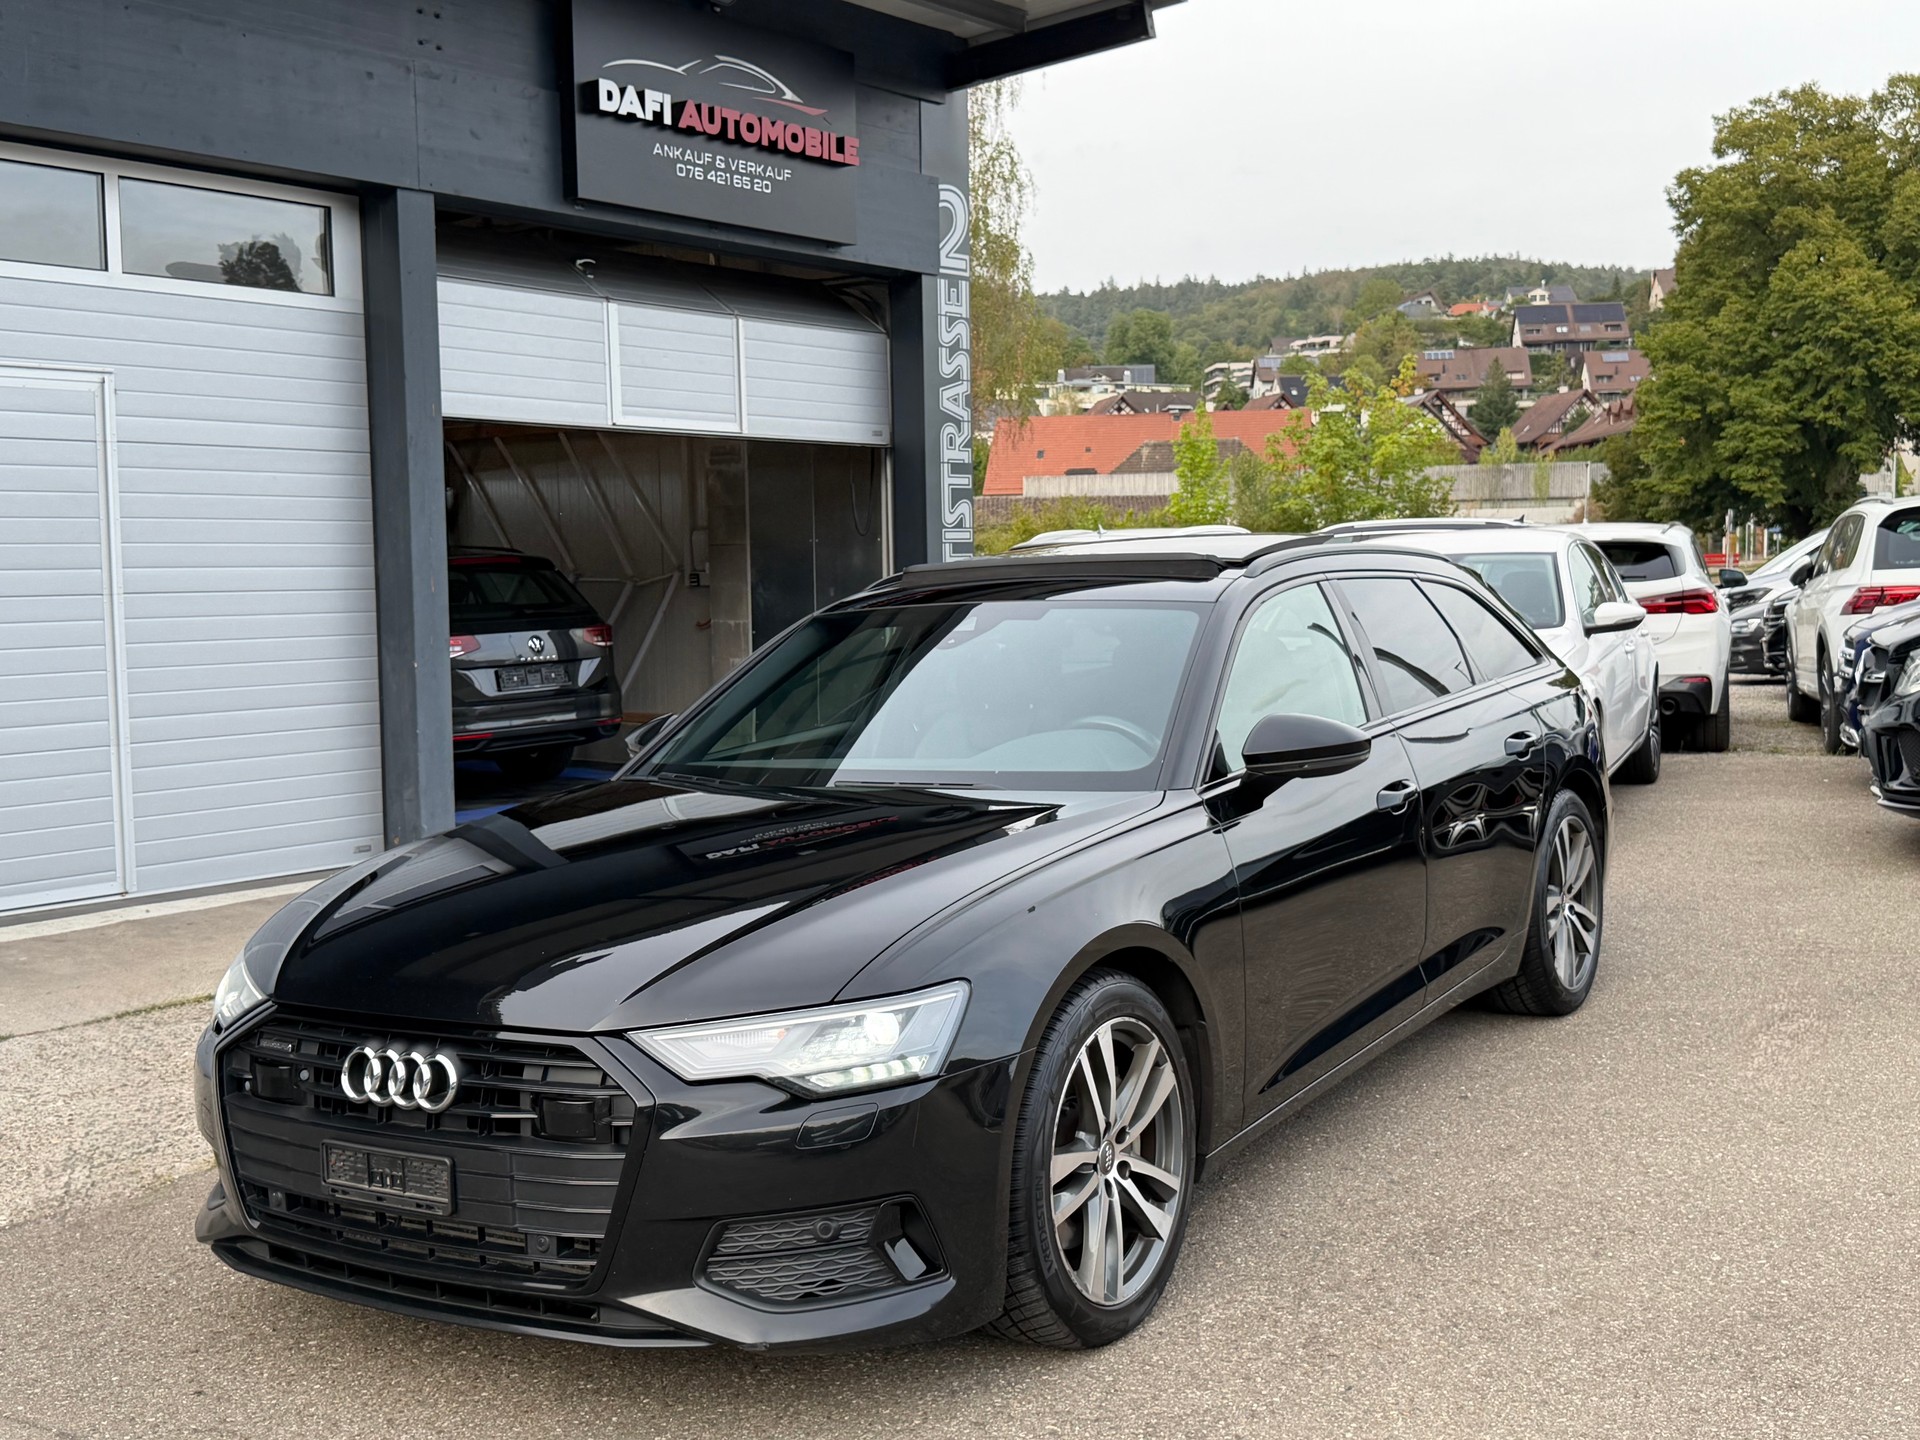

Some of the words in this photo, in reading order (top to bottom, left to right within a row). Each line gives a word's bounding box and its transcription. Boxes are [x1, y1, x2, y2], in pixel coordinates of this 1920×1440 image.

[598, 78, 672, 126] DAFI
[678, 99, 860, 166] AUTOMOBILE
[653, 143, 713, 165] ANKAUF
[716, 155, 726, 169] &
[729, 158, 792, 181] VERKAUF
[676, 163, 704, 180] 076
[707, 170, 731, 185] 421
[733, 174, 751, 190] 65
[754, 179, 772, 193] 20
[938, 184, 970, 277] 2
[1035, 1175, 1054, 1274] VREDESTEIN
